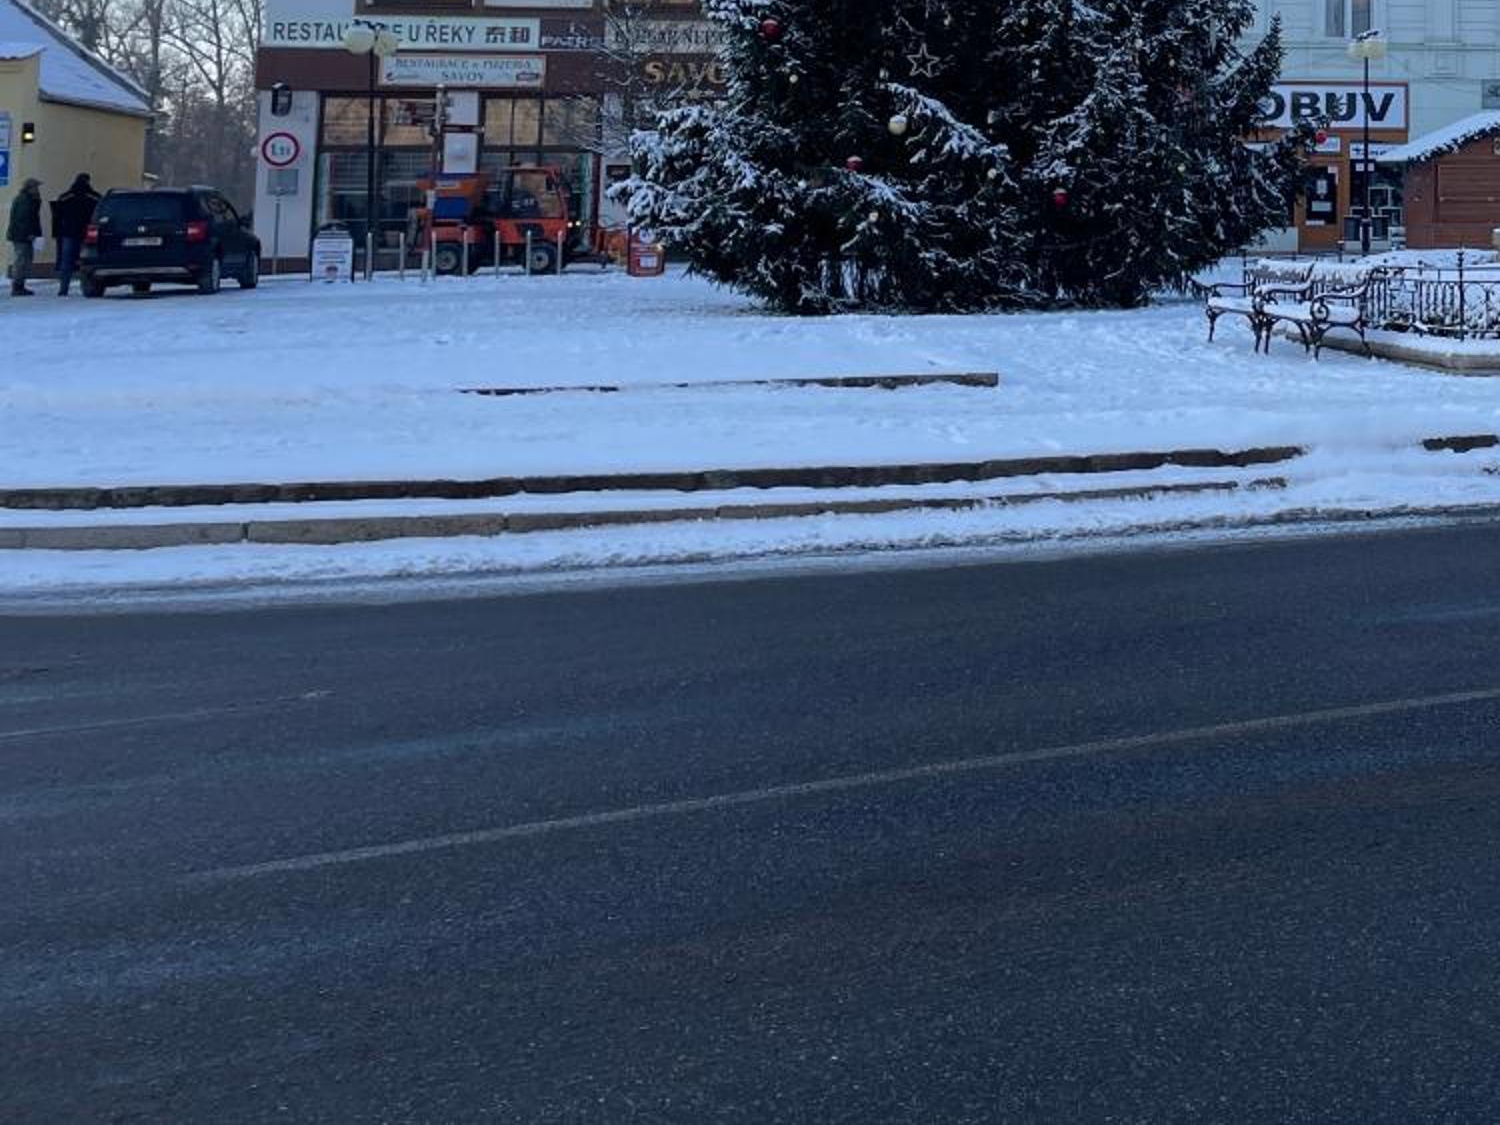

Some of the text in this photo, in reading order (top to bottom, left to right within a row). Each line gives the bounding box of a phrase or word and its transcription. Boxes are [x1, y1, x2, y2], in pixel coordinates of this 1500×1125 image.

[272, 19, 476, 44] RESTAUE U ŘEKY
